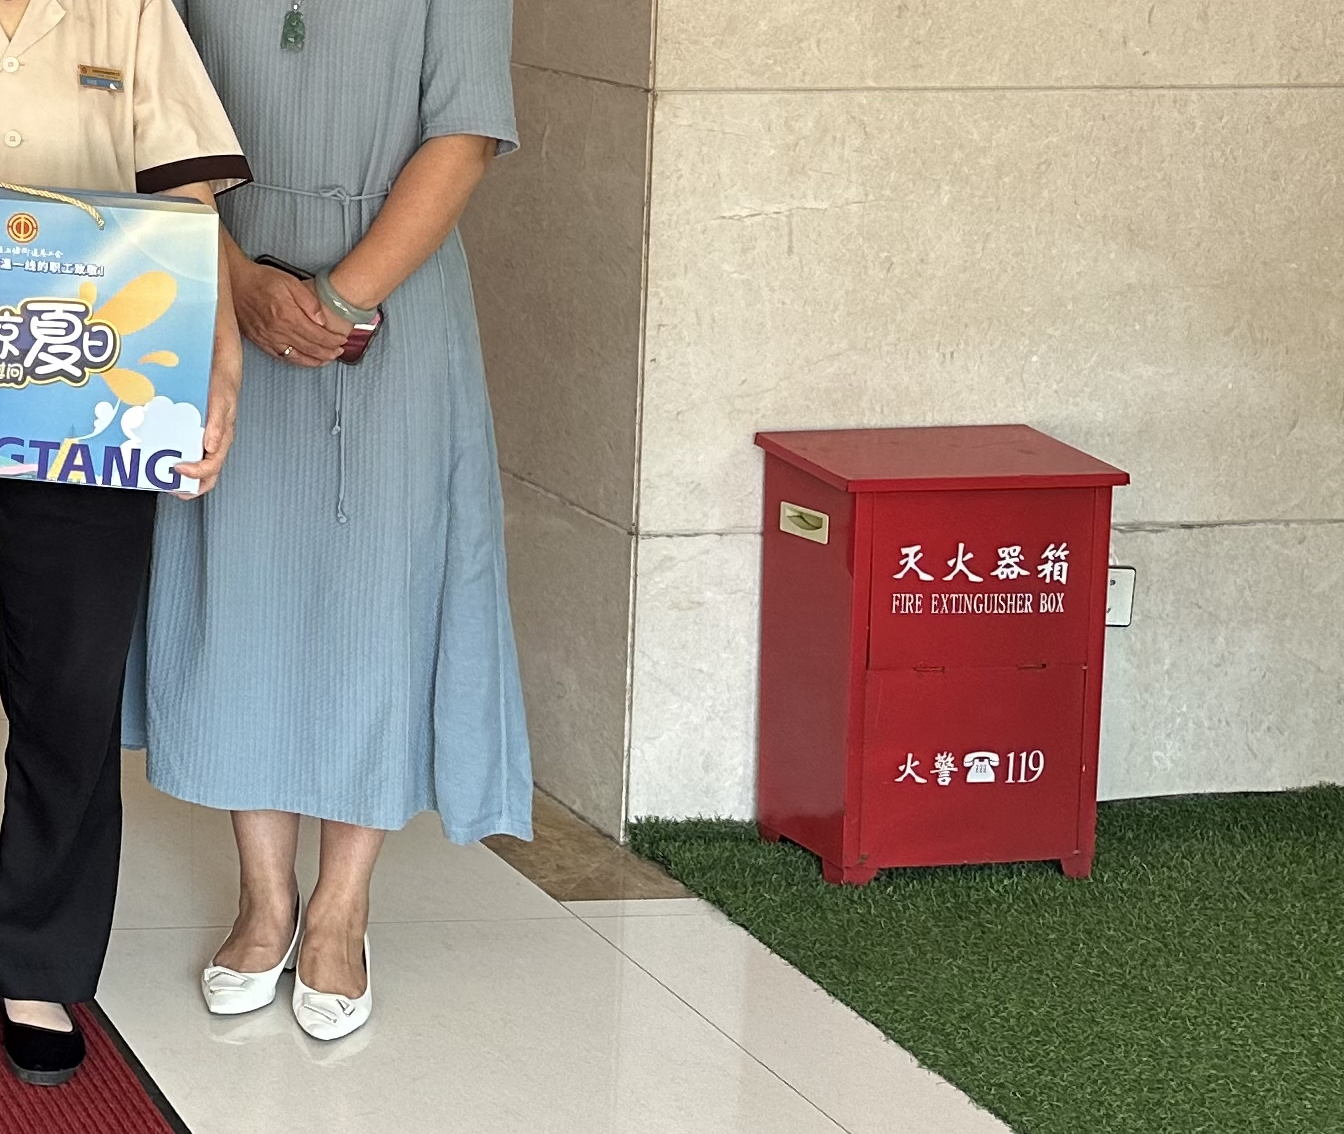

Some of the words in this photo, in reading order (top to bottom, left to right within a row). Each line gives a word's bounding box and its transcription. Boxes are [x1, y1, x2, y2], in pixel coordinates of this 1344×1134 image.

[892, 542, 1070, 585] 灭火器箱
[891, 593, 924, 614] FIRE
[930, 593, 1033, 614] EXTINGUISHER
[1039, 592, 1064, 613] BOX
[894, 751, 958, 786] 火警
[1005, 749, 1045, 784] 119
